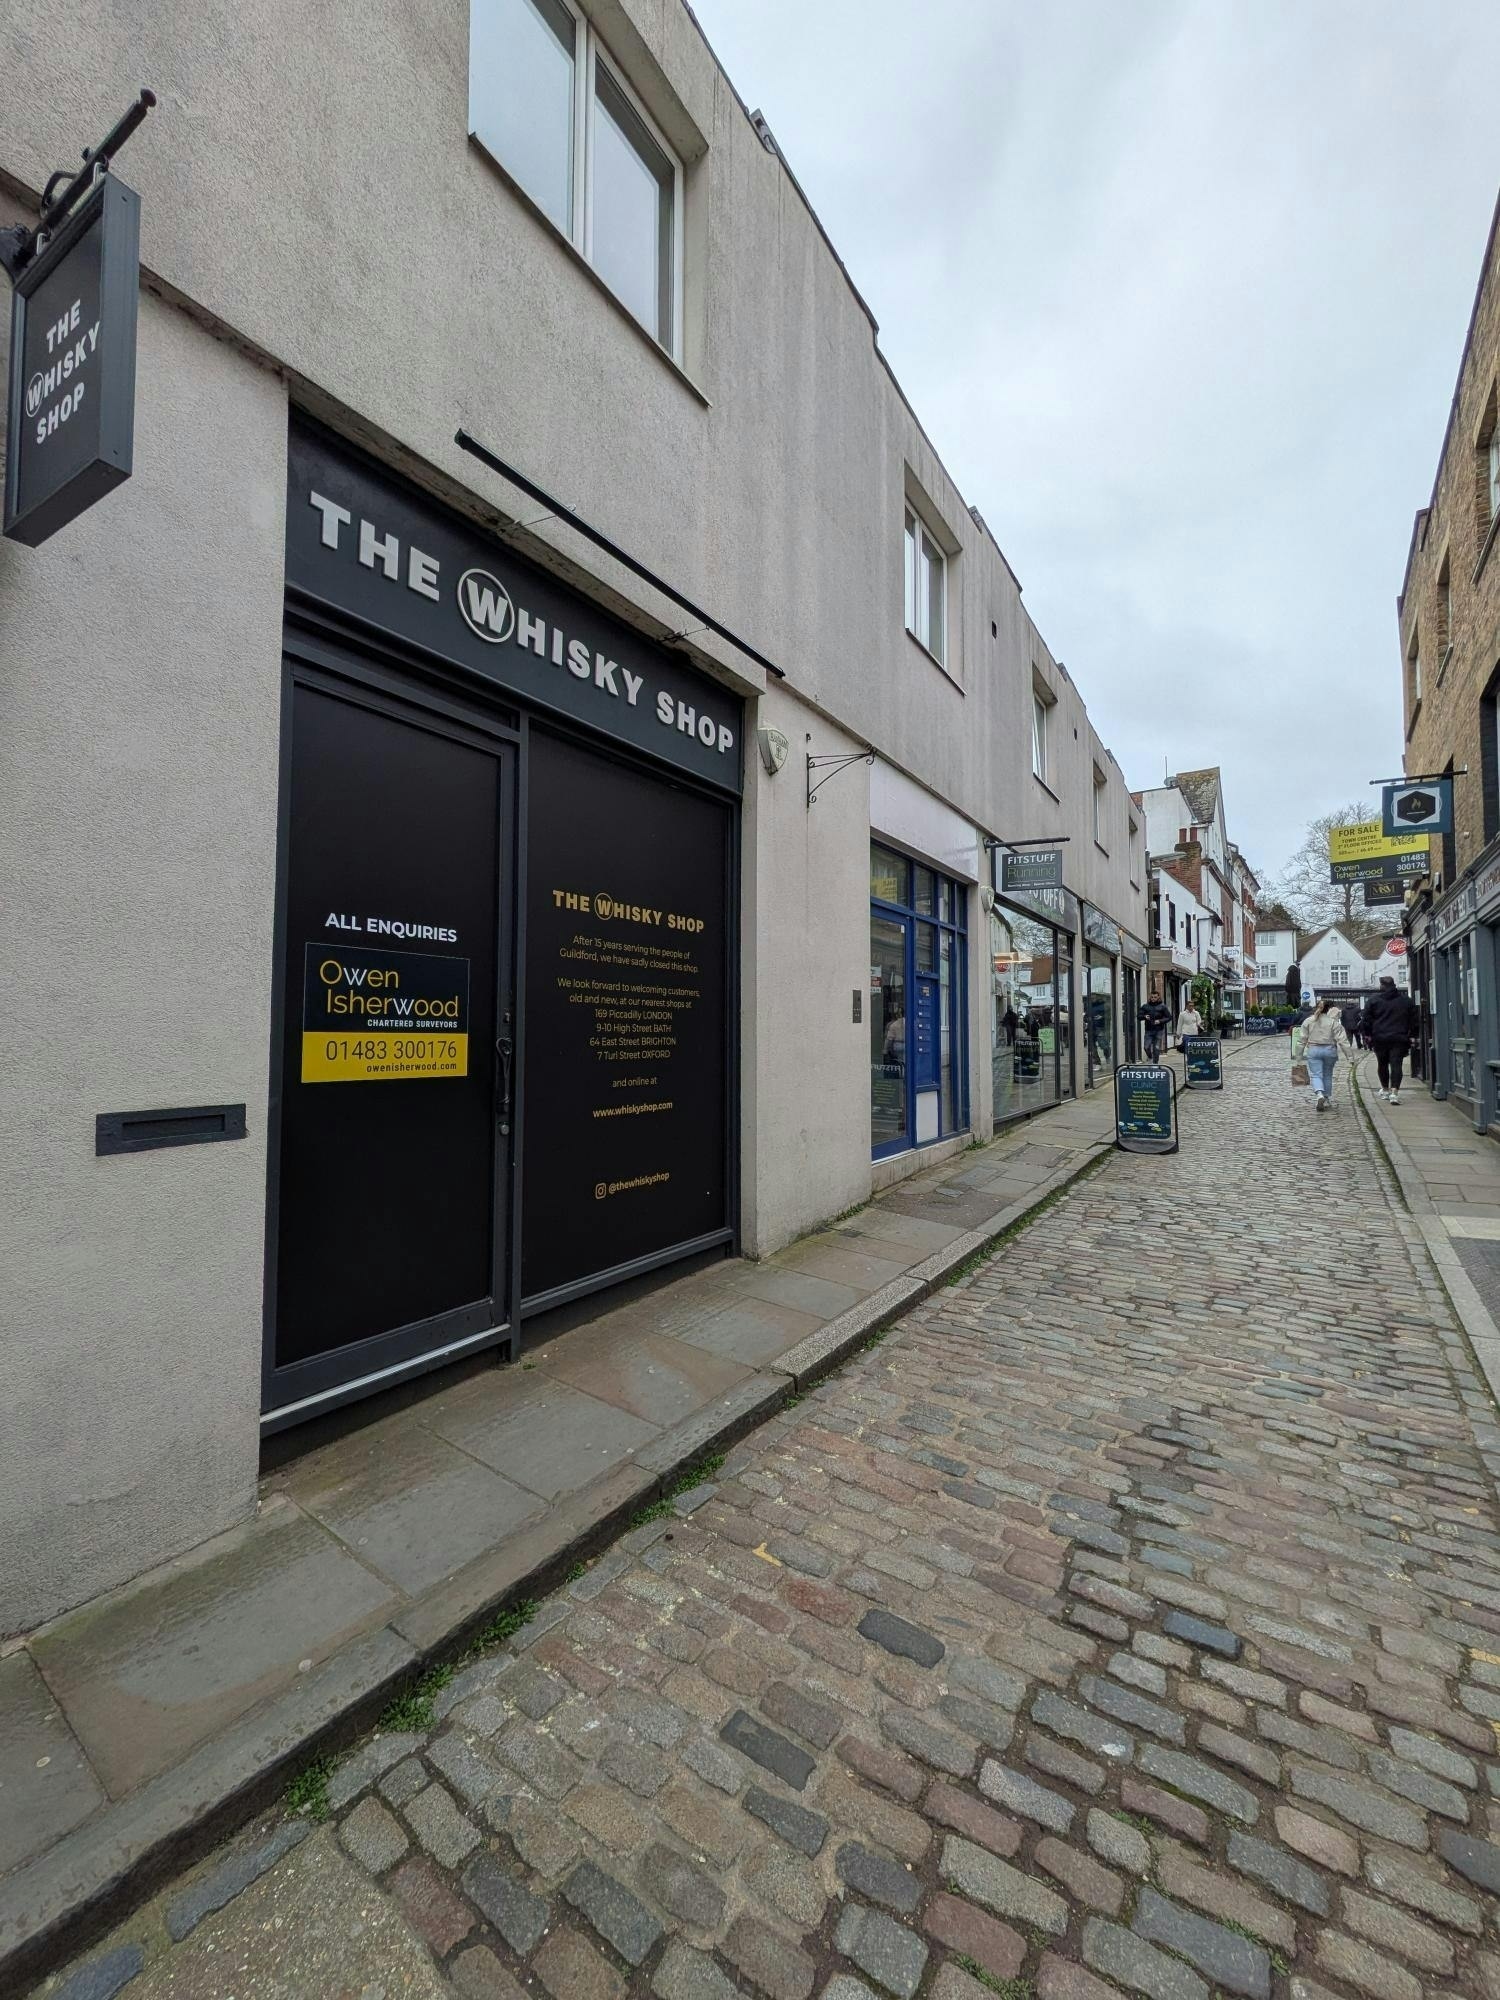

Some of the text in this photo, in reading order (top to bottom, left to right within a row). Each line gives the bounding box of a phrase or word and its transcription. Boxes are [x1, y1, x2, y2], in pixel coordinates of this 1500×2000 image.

[46, 299, 81, 353] THE
[26, 320, 101, 418] WHISKY
[36, 382, 85, 445] SHOP
[310, 489, 734, 754] THE WHISKY SHOP
[1338, 824, 1380, 838] FOR SALE
[1008, 854, 1056, 864] FITSTUFF
[1401, 853, 1425, 862] 01483
[1007, 867, 1056, 879] Running
[1333, 864, 1360, 873] Owen
[1336, 867, 1384, 880] Isherwood
[1396, 862, 1425, 871] 300176
[552, 889, 705, 933] THE WHISKY SHOP
[324, 912, 458, 943] ALL ENQUIRIES
[572, 935, 691, 961] After 15 years serving the people of
[600, 954, 612, 963] we
[612, 956, 631, 965] have
[631, 957, 649, 969] sadly
[650, 959, 671, 970] closed
[671, 961, 683, 972] this
[319, 960, 399, 989] Owen
[557, 977, 572, 988] We
[573, 977, 590, 989] look
[591, 980, 621, 991] forward
[621, 982, 630, 992] to
[630, 984, 667, 997] welcoming
[327, 988, 459, 1018] Isherwood
[569, 993, 583, 1003] old
[584, 995, 600, 1004] and
[619, 997, 628, 1005] at
[628, 998, 641, 1006] our
[641, 999, 666, 1008] nearest
[665, 1000, 685, 1010] shops
[685, 1001, 693, 1009] at
[594, 1008, 673, 1021] 169 Piccadilly LONDON
[367, 1018, 458, 1029] CHARTERED SURVEYORS
[596, 1022, 672, 1035] 9-10 High Street BATH
[589, 1036, 677, 1047] 64 East Street BRIGHTON
[326, 1040, 457, 1061] 01483 300176
[597, 1051, 603, 1061] 7
[619, 1051, 641, 1060] Street
[641, 1049, 671, 1059] OXFORD
[366, 1062, 457, 1072] owenisherwood.com
[612, 1076, 657, 1088] and online at
[1121, 1071, 1167, 1079] FITSTUFF
[592, 1101, 673, 1118] www.whiskyshop.com
[608, 1171, 670, 1194] @thewhiskyshop
